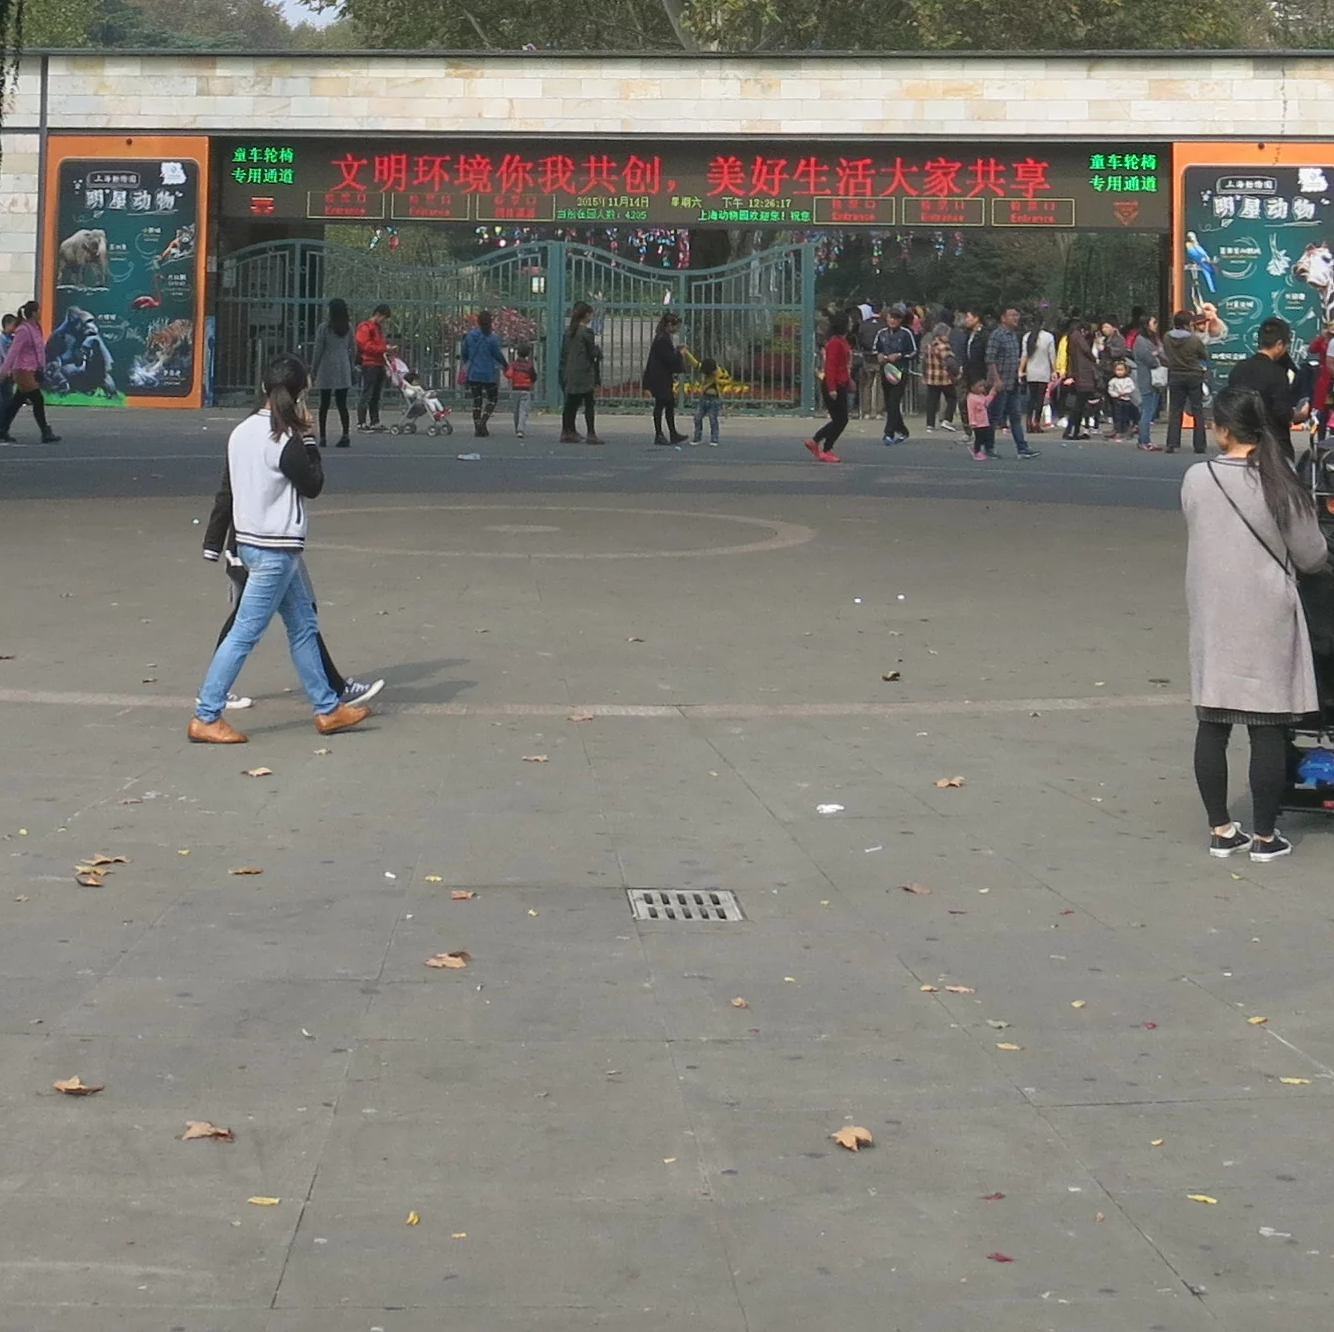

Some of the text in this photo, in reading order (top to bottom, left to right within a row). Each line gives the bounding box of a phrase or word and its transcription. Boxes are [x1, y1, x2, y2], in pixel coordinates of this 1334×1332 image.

[231, 147, 295, 164] 童车轮椅
[1088, 153, 1158, 171] 童车轮椅
[231, 167, 295, 184] 专用通道
[1088, 175, 1158, 192] 专用通道
[85, 188, 176, 210] 明星动物
[721, 196, 744, 209] 下午
[1212, 195, 1316, 220] 明星动物
